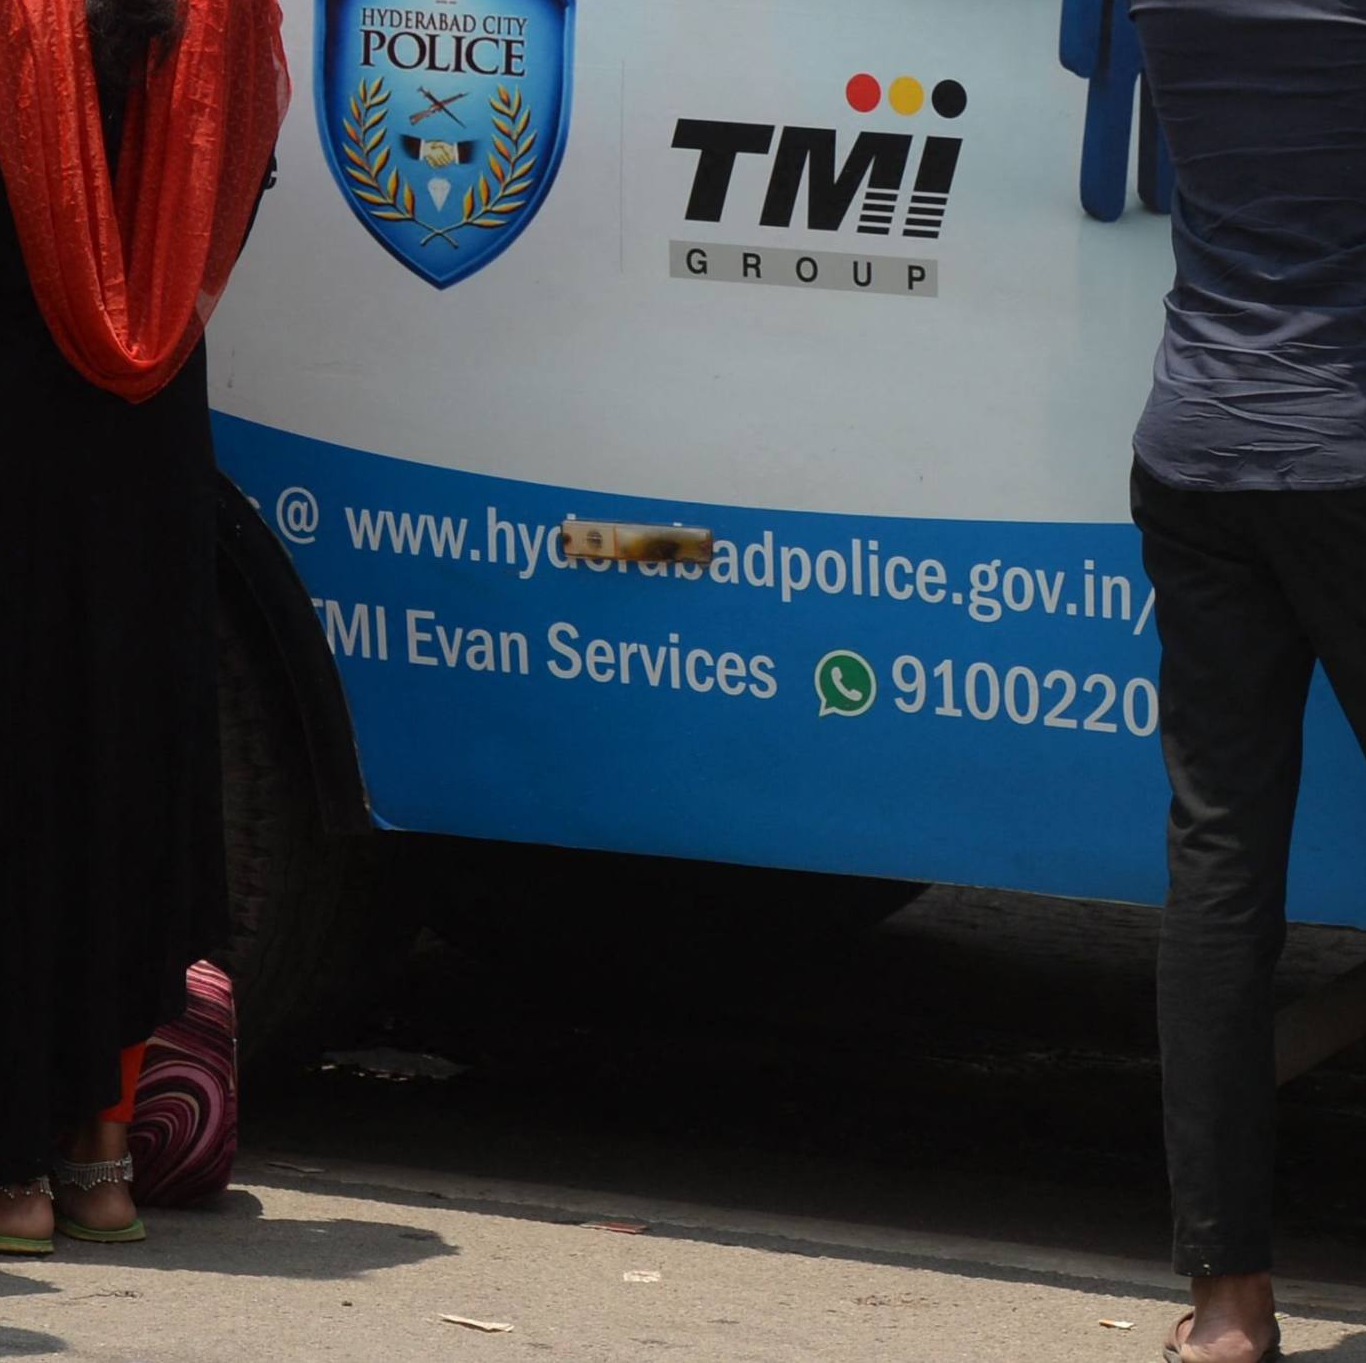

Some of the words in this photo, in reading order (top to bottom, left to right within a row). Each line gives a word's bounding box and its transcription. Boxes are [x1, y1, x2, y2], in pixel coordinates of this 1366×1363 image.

[361, 7, 477, 33] HYDERABAD
[482, 16, 528, 36] CITY
[359, 28, 526, 77] POLICE
[686, 248, 927, 290] GROUP
[276, 486, 319, 545] @
[310, 597, 388, 661] MI
[406, 609, 530, 676] Evan
[546, 621, 778, 701] Services
[891, 654, 1159, 737] 9100220
